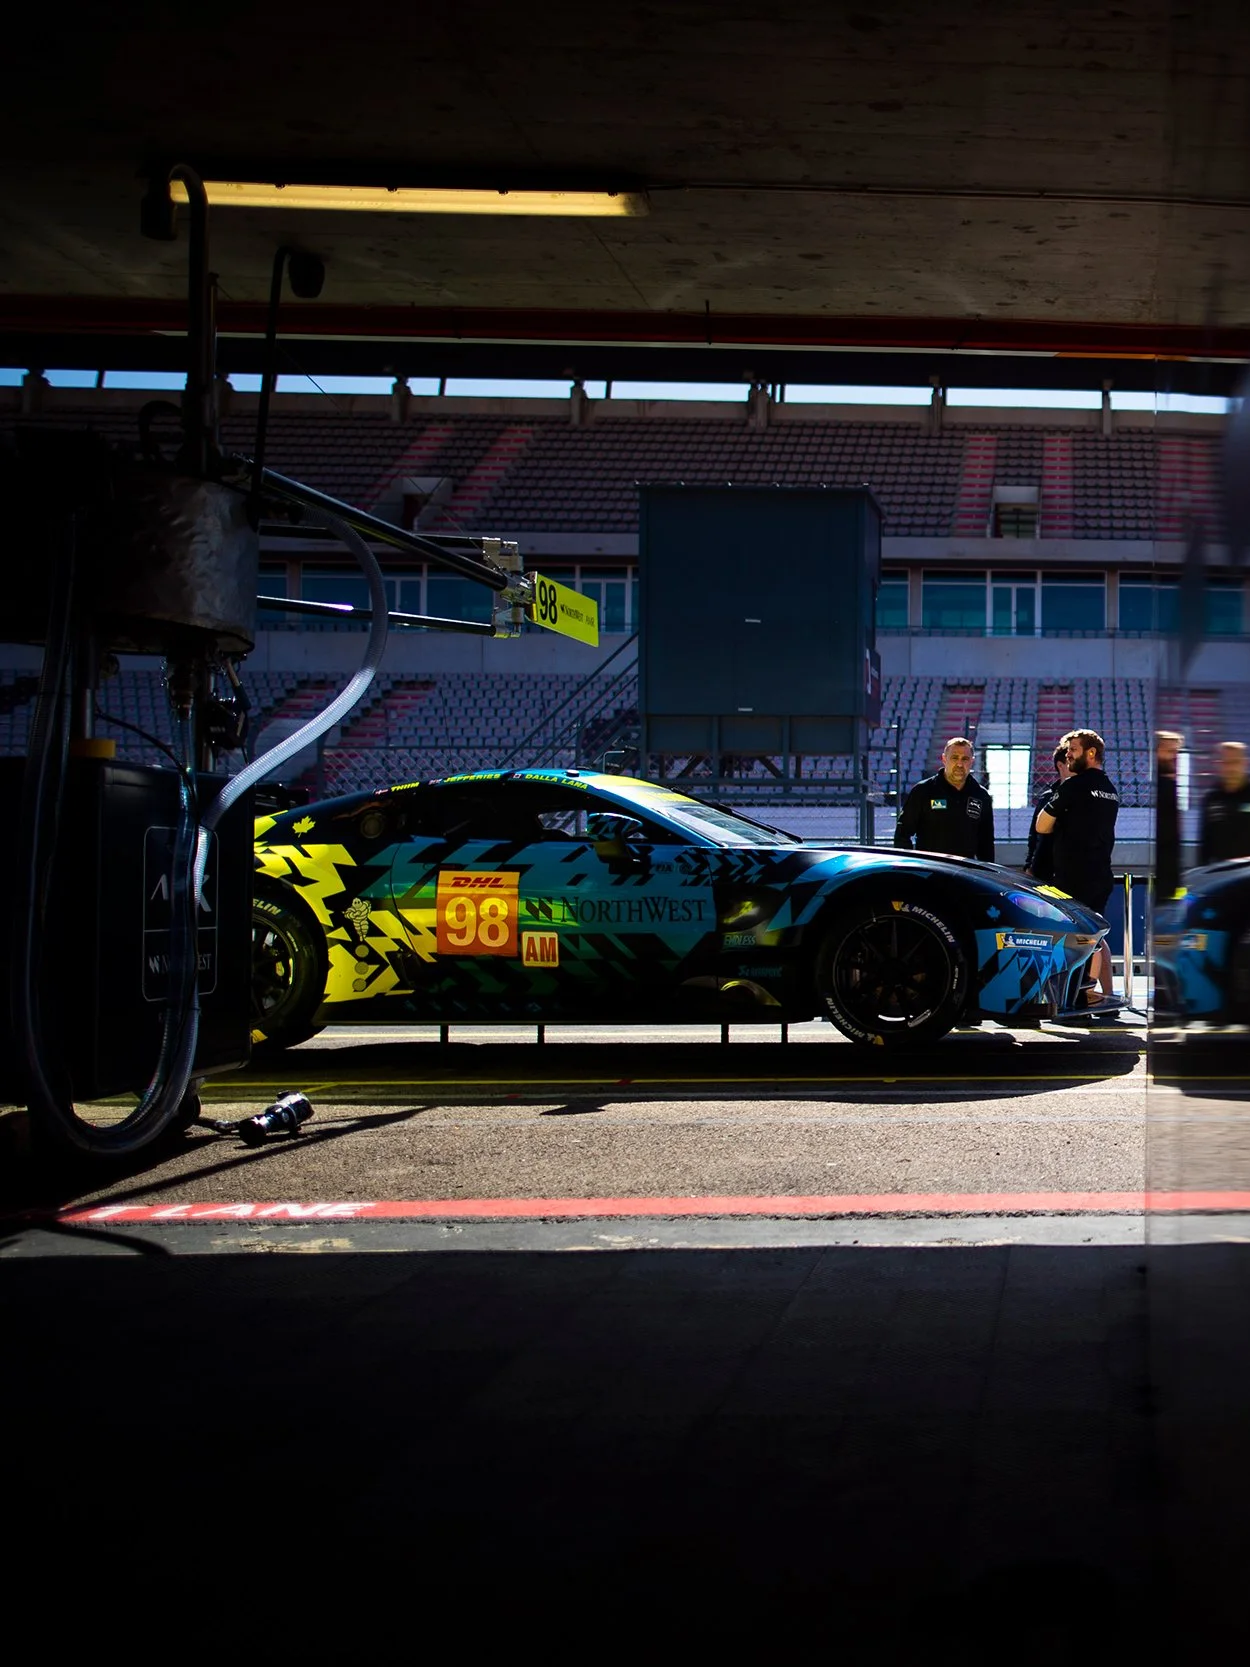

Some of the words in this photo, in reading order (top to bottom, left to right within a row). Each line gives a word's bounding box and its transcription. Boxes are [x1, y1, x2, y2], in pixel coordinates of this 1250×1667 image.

[539, 581, 557, 624] 98
[443, 773, 501, 783] JEFFERIES
[525, 774, 558, 783] DALLA
[560, 778, 589, 791] LANA
[391, 781, 420, 792] THIIM
[450, 876, 505, 889] DHL
[445, 896, 510, 948] 98
[911, 903, 956, 944] MICHELIN
[723, 935, 757, 947] ENDLESS
[1015, 937, 1049, 948] MICHELIN
[525, 936, 557, 963] AM
[825, 997, 866, 1039] MICHELIN
[150, 1203, 378, 1218] LANE
